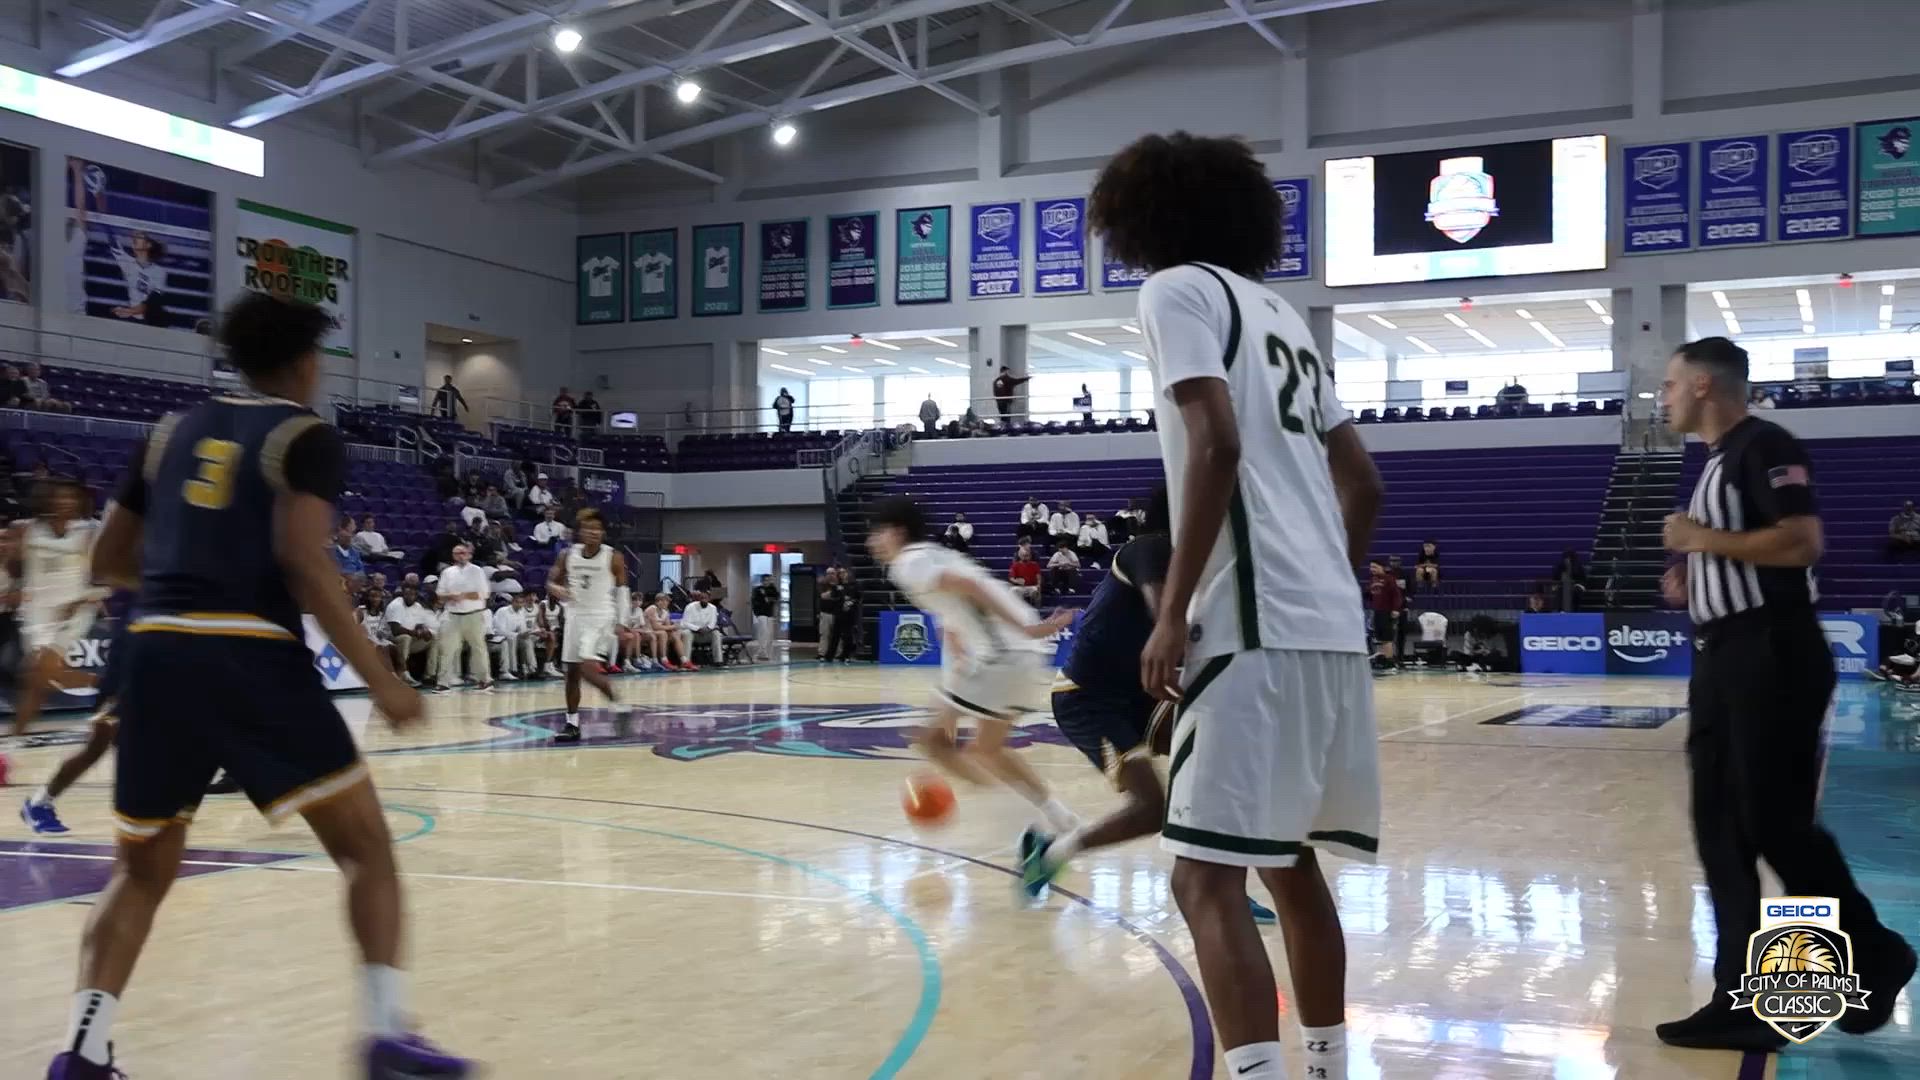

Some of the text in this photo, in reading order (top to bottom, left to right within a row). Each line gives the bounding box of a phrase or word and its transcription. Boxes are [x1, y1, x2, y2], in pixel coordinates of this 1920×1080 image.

[1786, 216, 1841, 234] 2022
[236, 236, 351, 281] CROWTHER
[244, 265, 339, 305] ROOFING
[182, 437, 244, 511] 3
[1523, 636, 1602, 652] GEICO
[1608, 625, 1688, 647] alexa+
